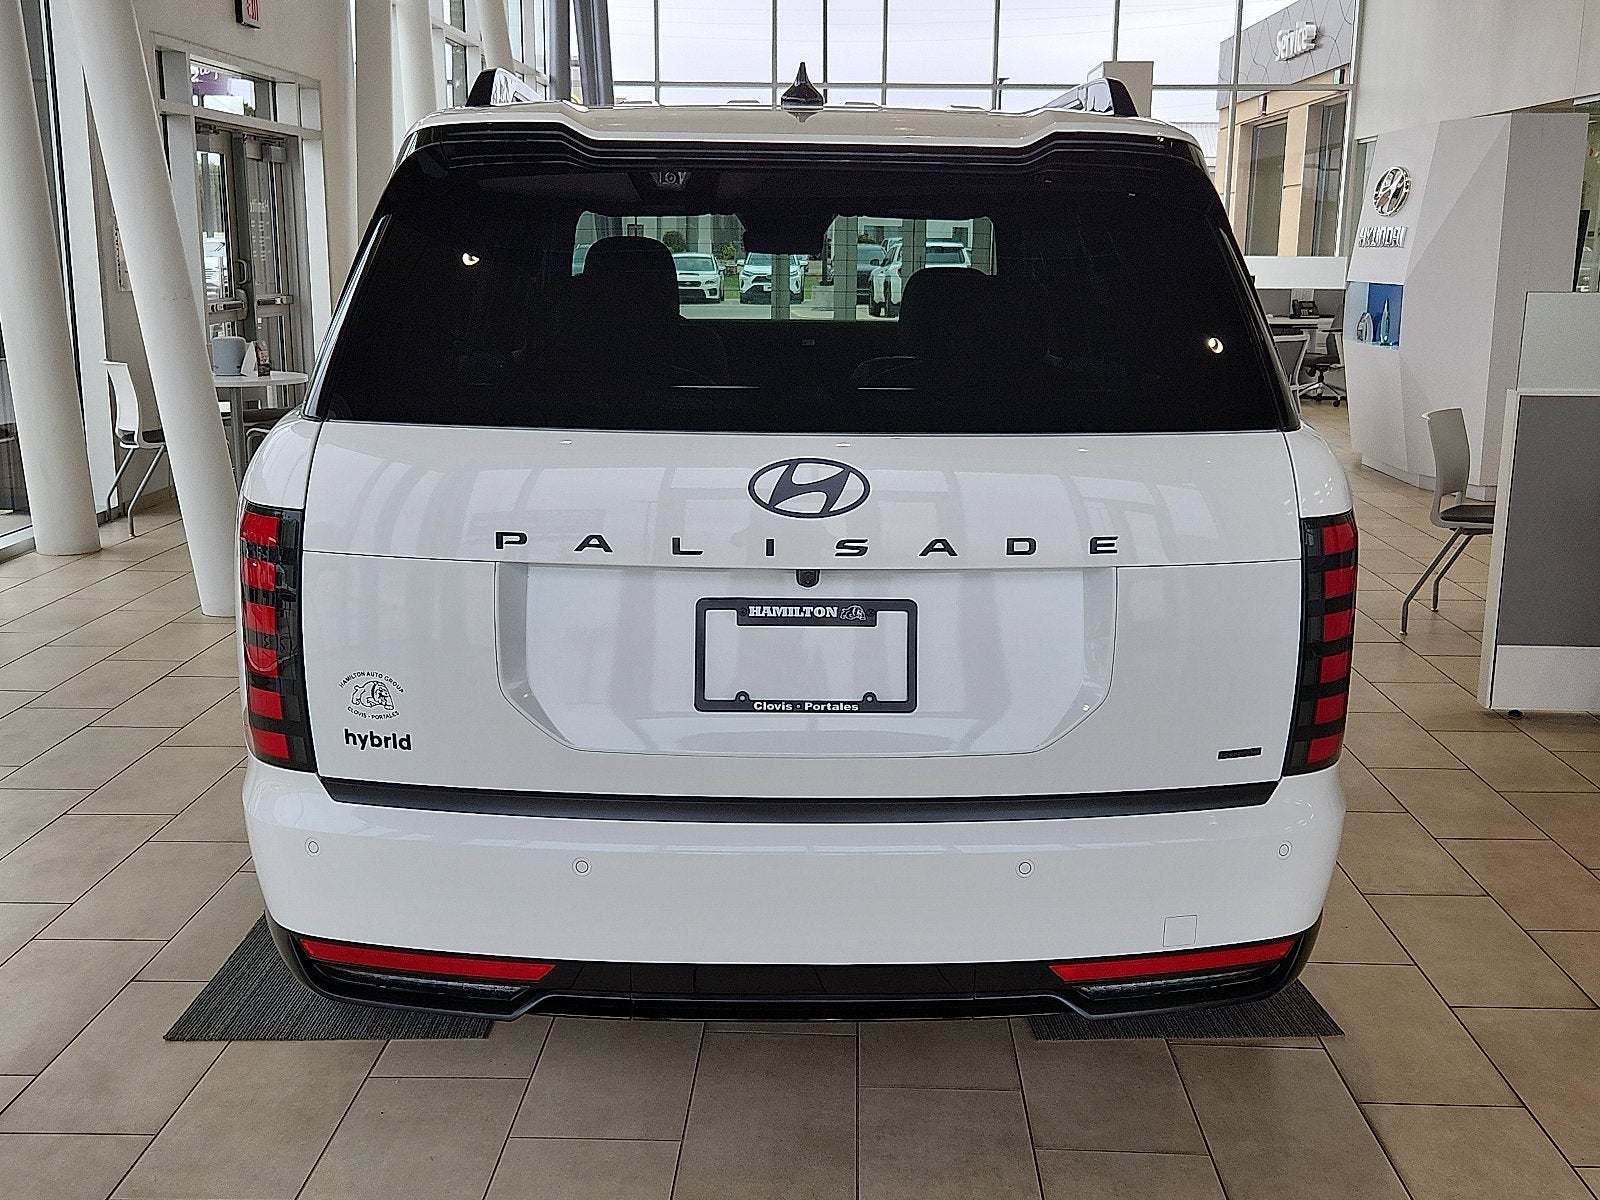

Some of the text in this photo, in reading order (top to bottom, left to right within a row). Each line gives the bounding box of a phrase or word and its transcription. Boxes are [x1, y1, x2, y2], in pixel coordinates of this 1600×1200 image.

[1275, 21, 1316, 61] Service
[1359, 226, 1408, 248] HYUNDAI
[495, 531, 1120, 557] PALISADE
[748, 605, 839, 618] HAMILTON
[339, 671, 404, 693] HAMILTON AUTO GROUP
[347, 706, 400, 720] CLOVIS PORTALES
[753, 701, 859, 711] Clovis Portales
[344, 728, 412, 750] hybrid
